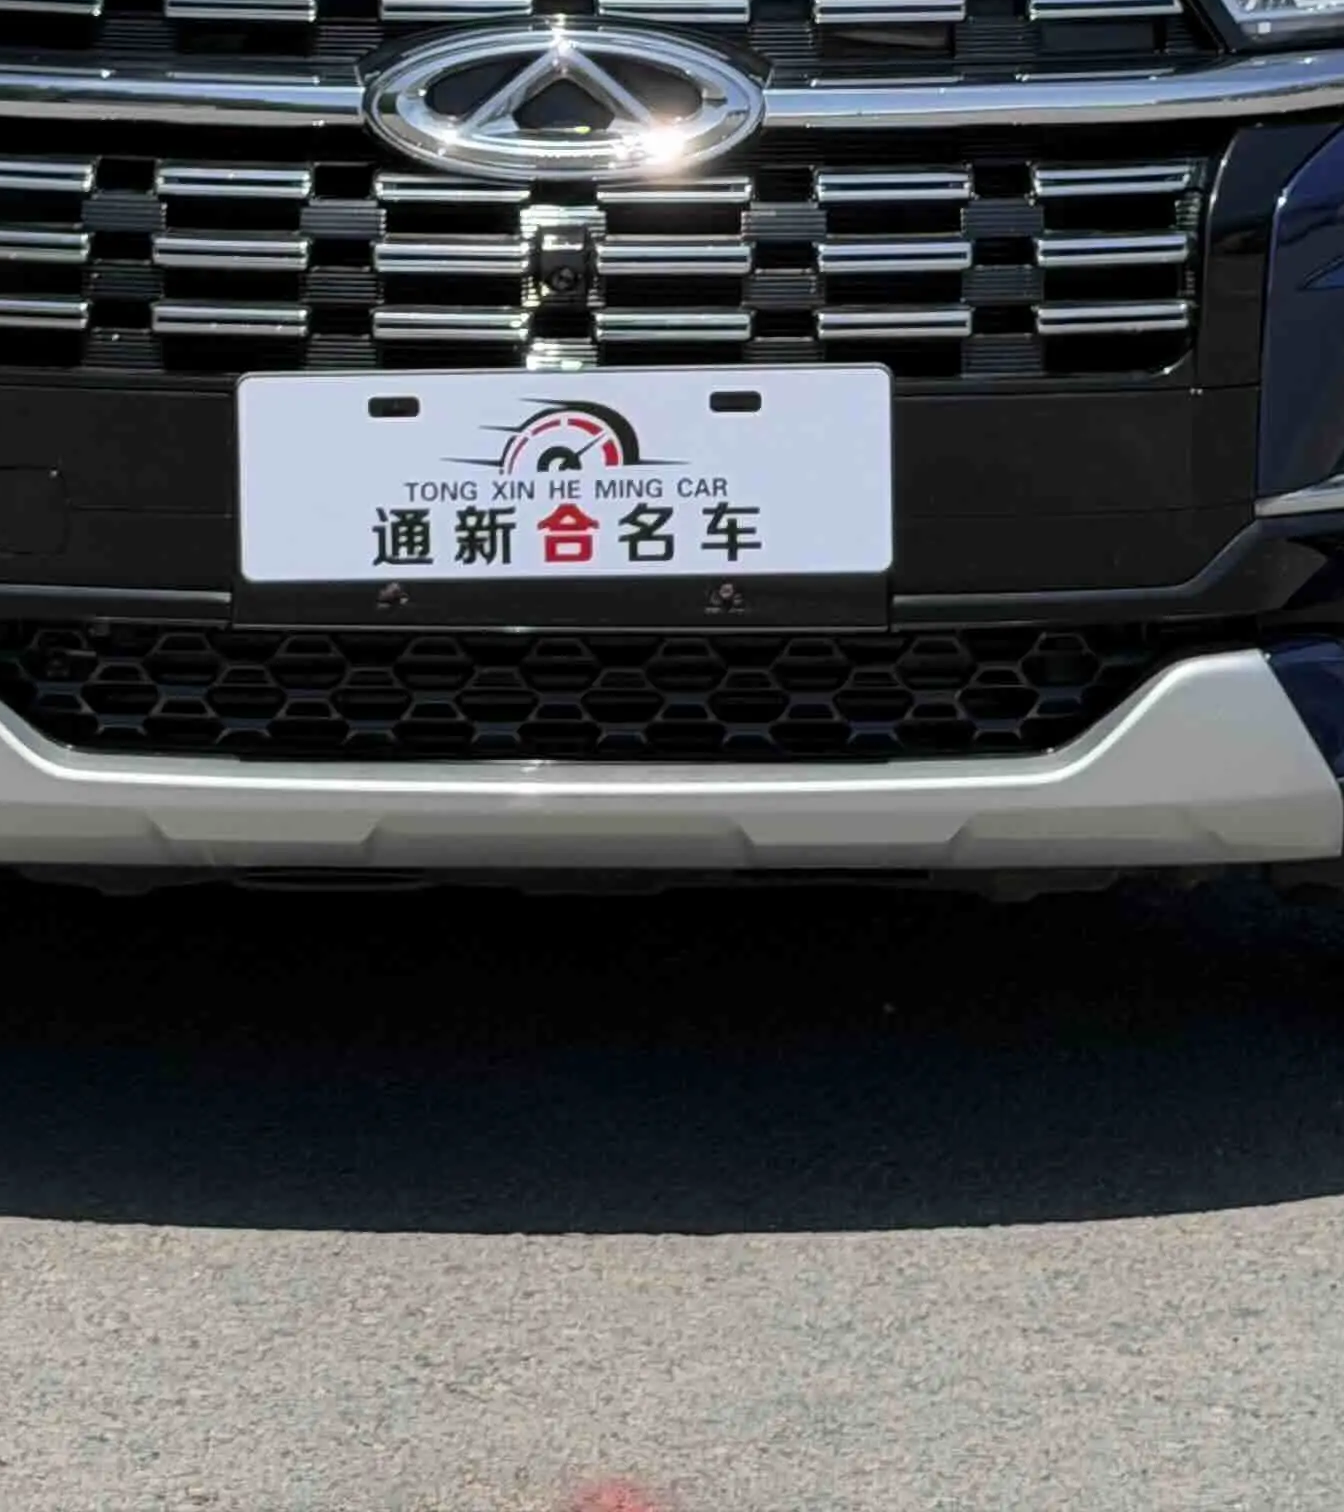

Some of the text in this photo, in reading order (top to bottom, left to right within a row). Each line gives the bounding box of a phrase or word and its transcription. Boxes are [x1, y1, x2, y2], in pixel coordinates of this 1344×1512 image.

[404, 477, 728, 502] TONG XIN HE MING CAR
[371, 502, 763, 567] 通新合名车
